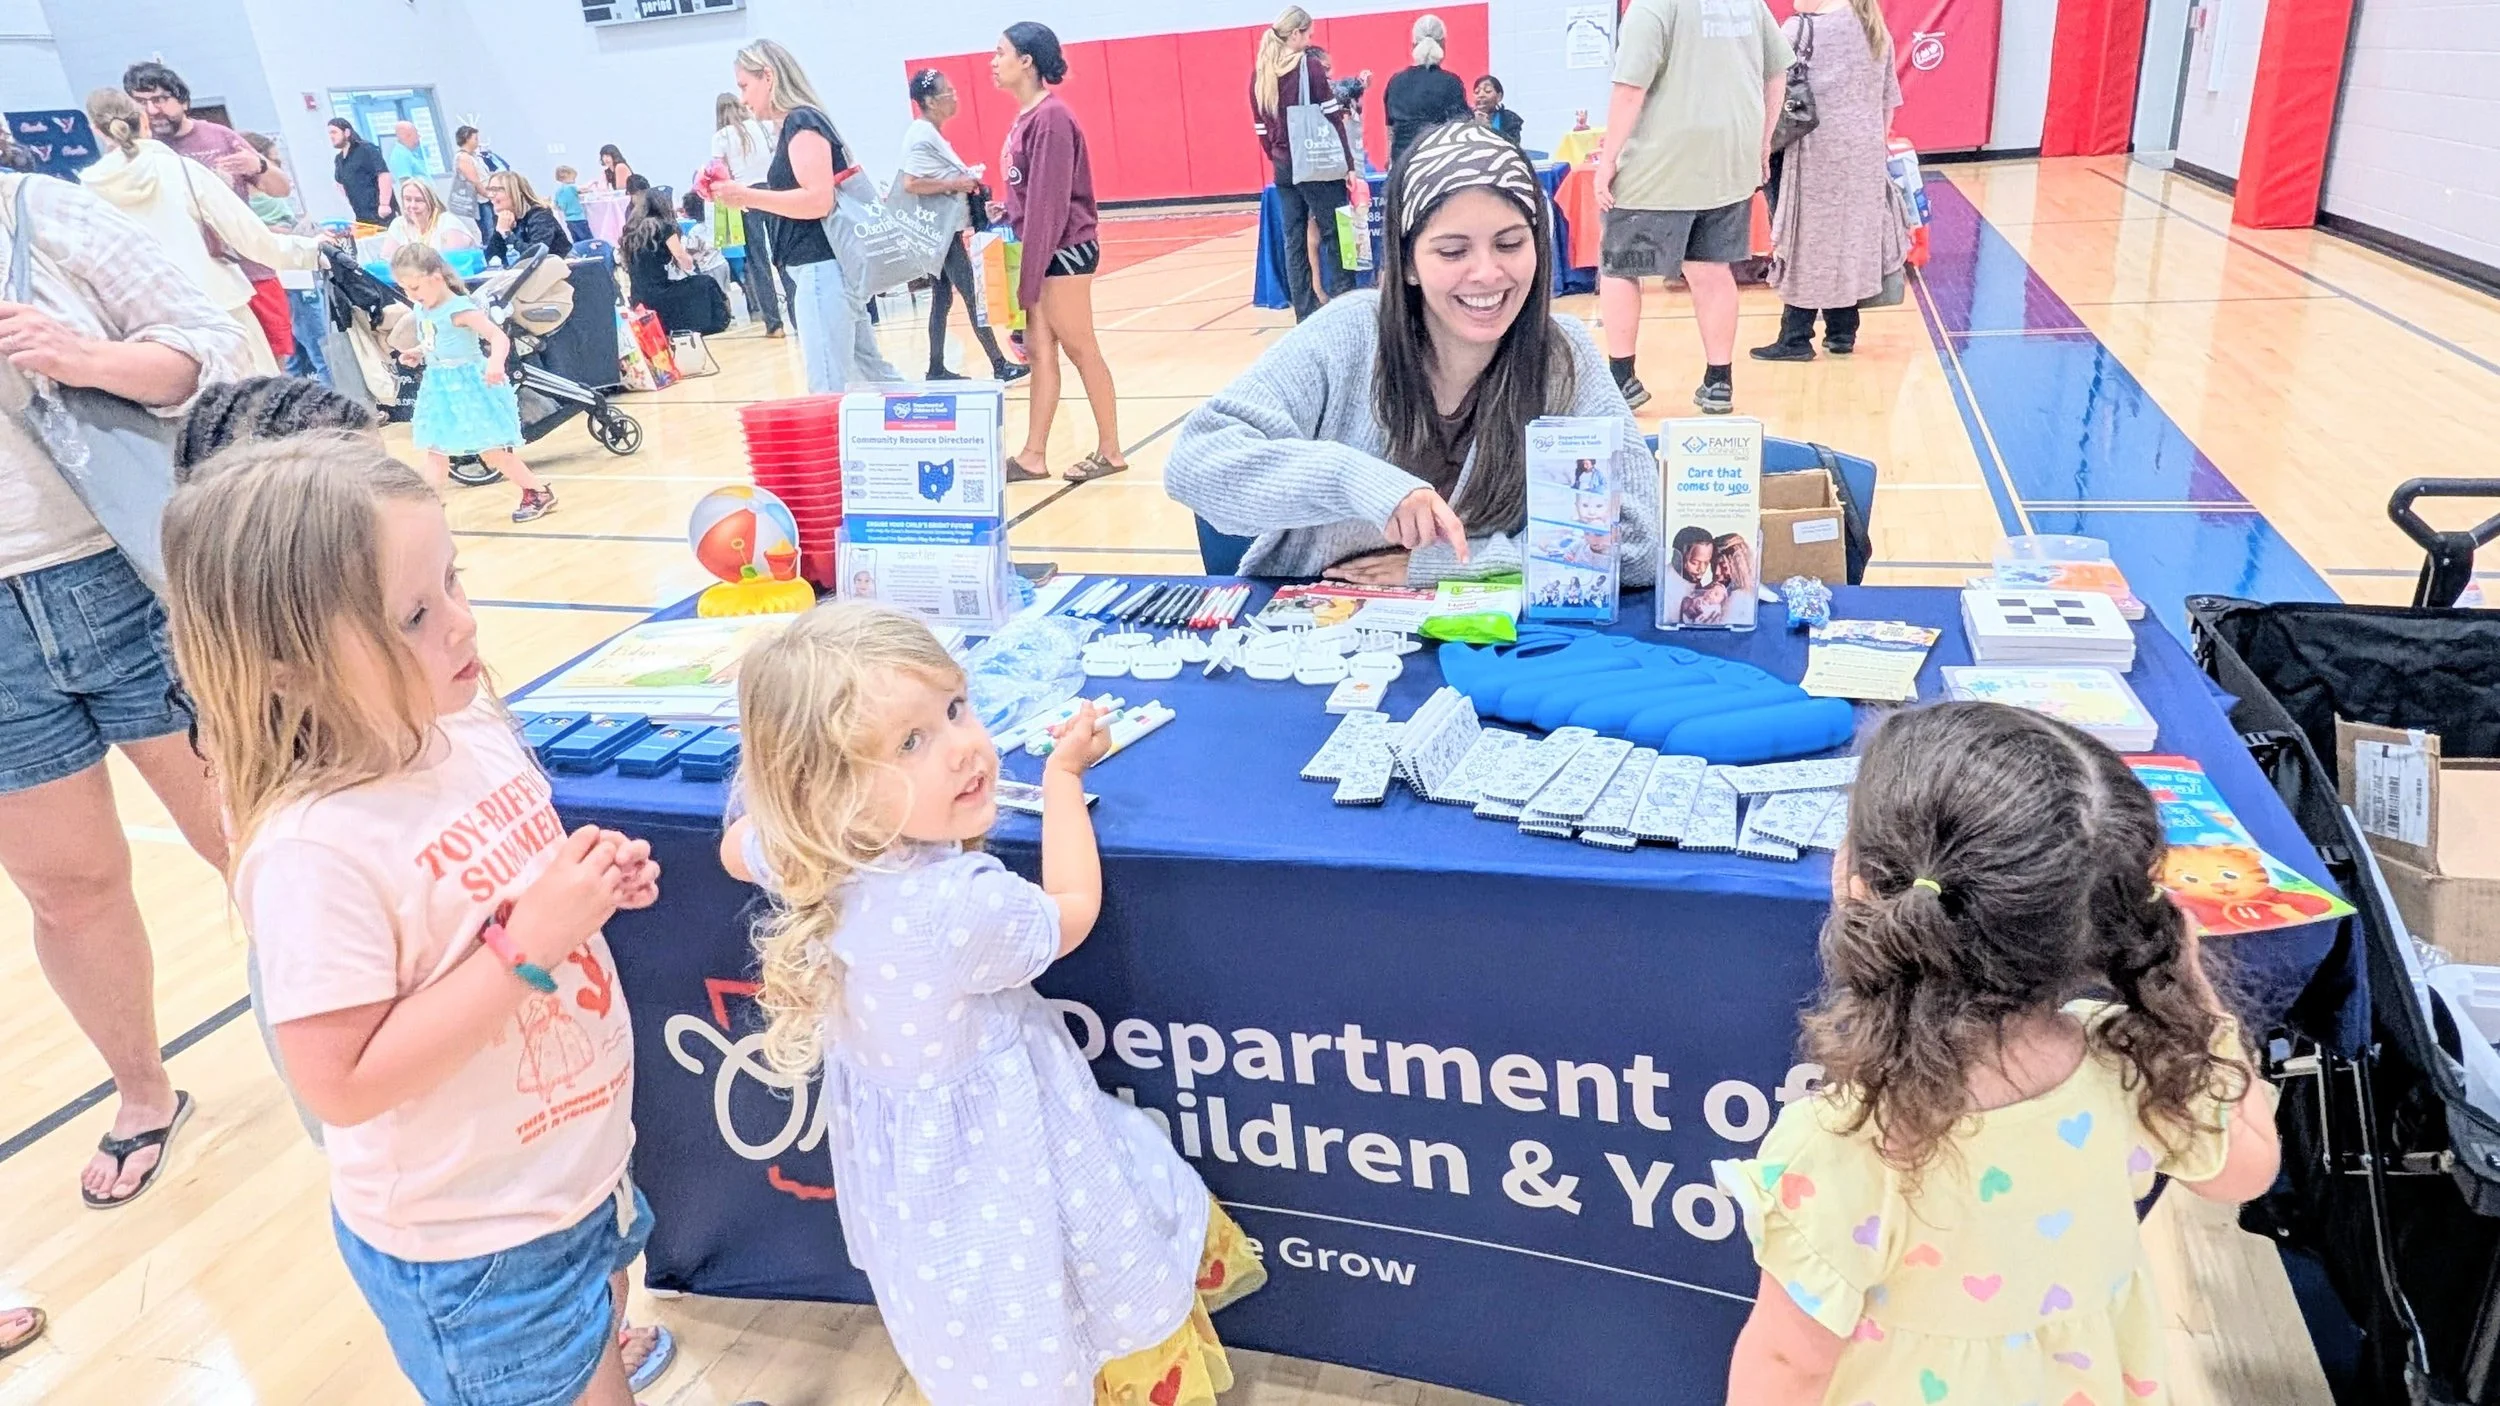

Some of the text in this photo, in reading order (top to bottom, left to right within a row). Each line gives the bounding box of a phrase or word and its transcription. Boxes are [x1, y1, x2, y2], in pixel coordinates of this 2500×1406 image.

[851, 436, 985, 446] Community Resource Directories
[1708, 437, 1751, 448] FAMILY
[1687, 466, 1742, 478] Care that
[1676, 482, 1709, 492] comes
[1713, 481, 1725, 492] to
[1042, 997, 1671, 1131] Department
[1500, 1139, 1582, 1215] &
[1278, 1237, 1417, 1287] Grow
